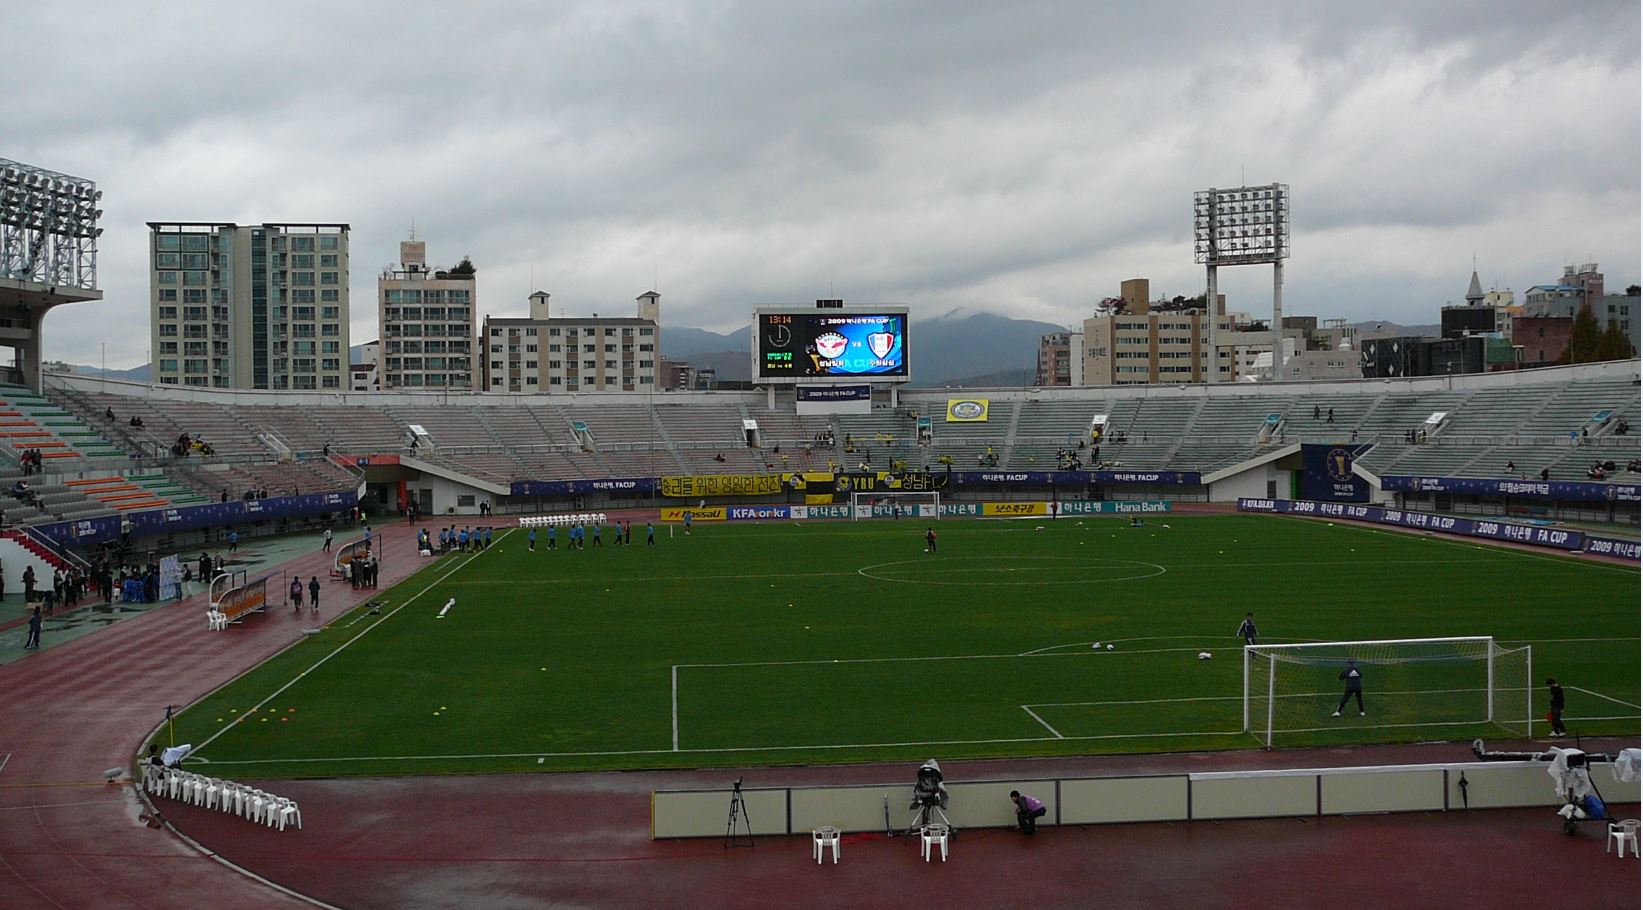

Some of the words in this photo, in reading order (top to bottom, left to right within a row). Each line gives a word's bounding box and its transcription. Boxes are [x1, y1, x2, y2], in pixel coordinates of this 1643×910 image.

[769, 316, 791, 324] 13:14
[663, 477, 693, 495] 승리를
[696, 477, 718, 494] 위한
[721, 476, 754, 493] 영원한
[757, 475, 780, 492] 전진
[809, 506, 848, 517] 하나은행
[939, 504, 976, 515] 하나은행
[1064, 502, 1102, 513] 하나은행
[1115, 502, 1140, 513] Hana
[1141, 502, 1166, 512] Bank
[1294, 502, 1315, 512] 2009
[1347, 505, 1356, 516] FA
[1355, 506, 1368, 517] CUP
[1385, 510, 1401, 521] 2009
[1431, 516, 1440, 526] FA
[1441, 518, 1455, 529] CUP
[1478, 522, 1498, 534] 2009
[1537, 529, 1548, 541] FA
[1550, 531, 1568, 544] CUP
[1590, 540, 1612, 552] 2009
